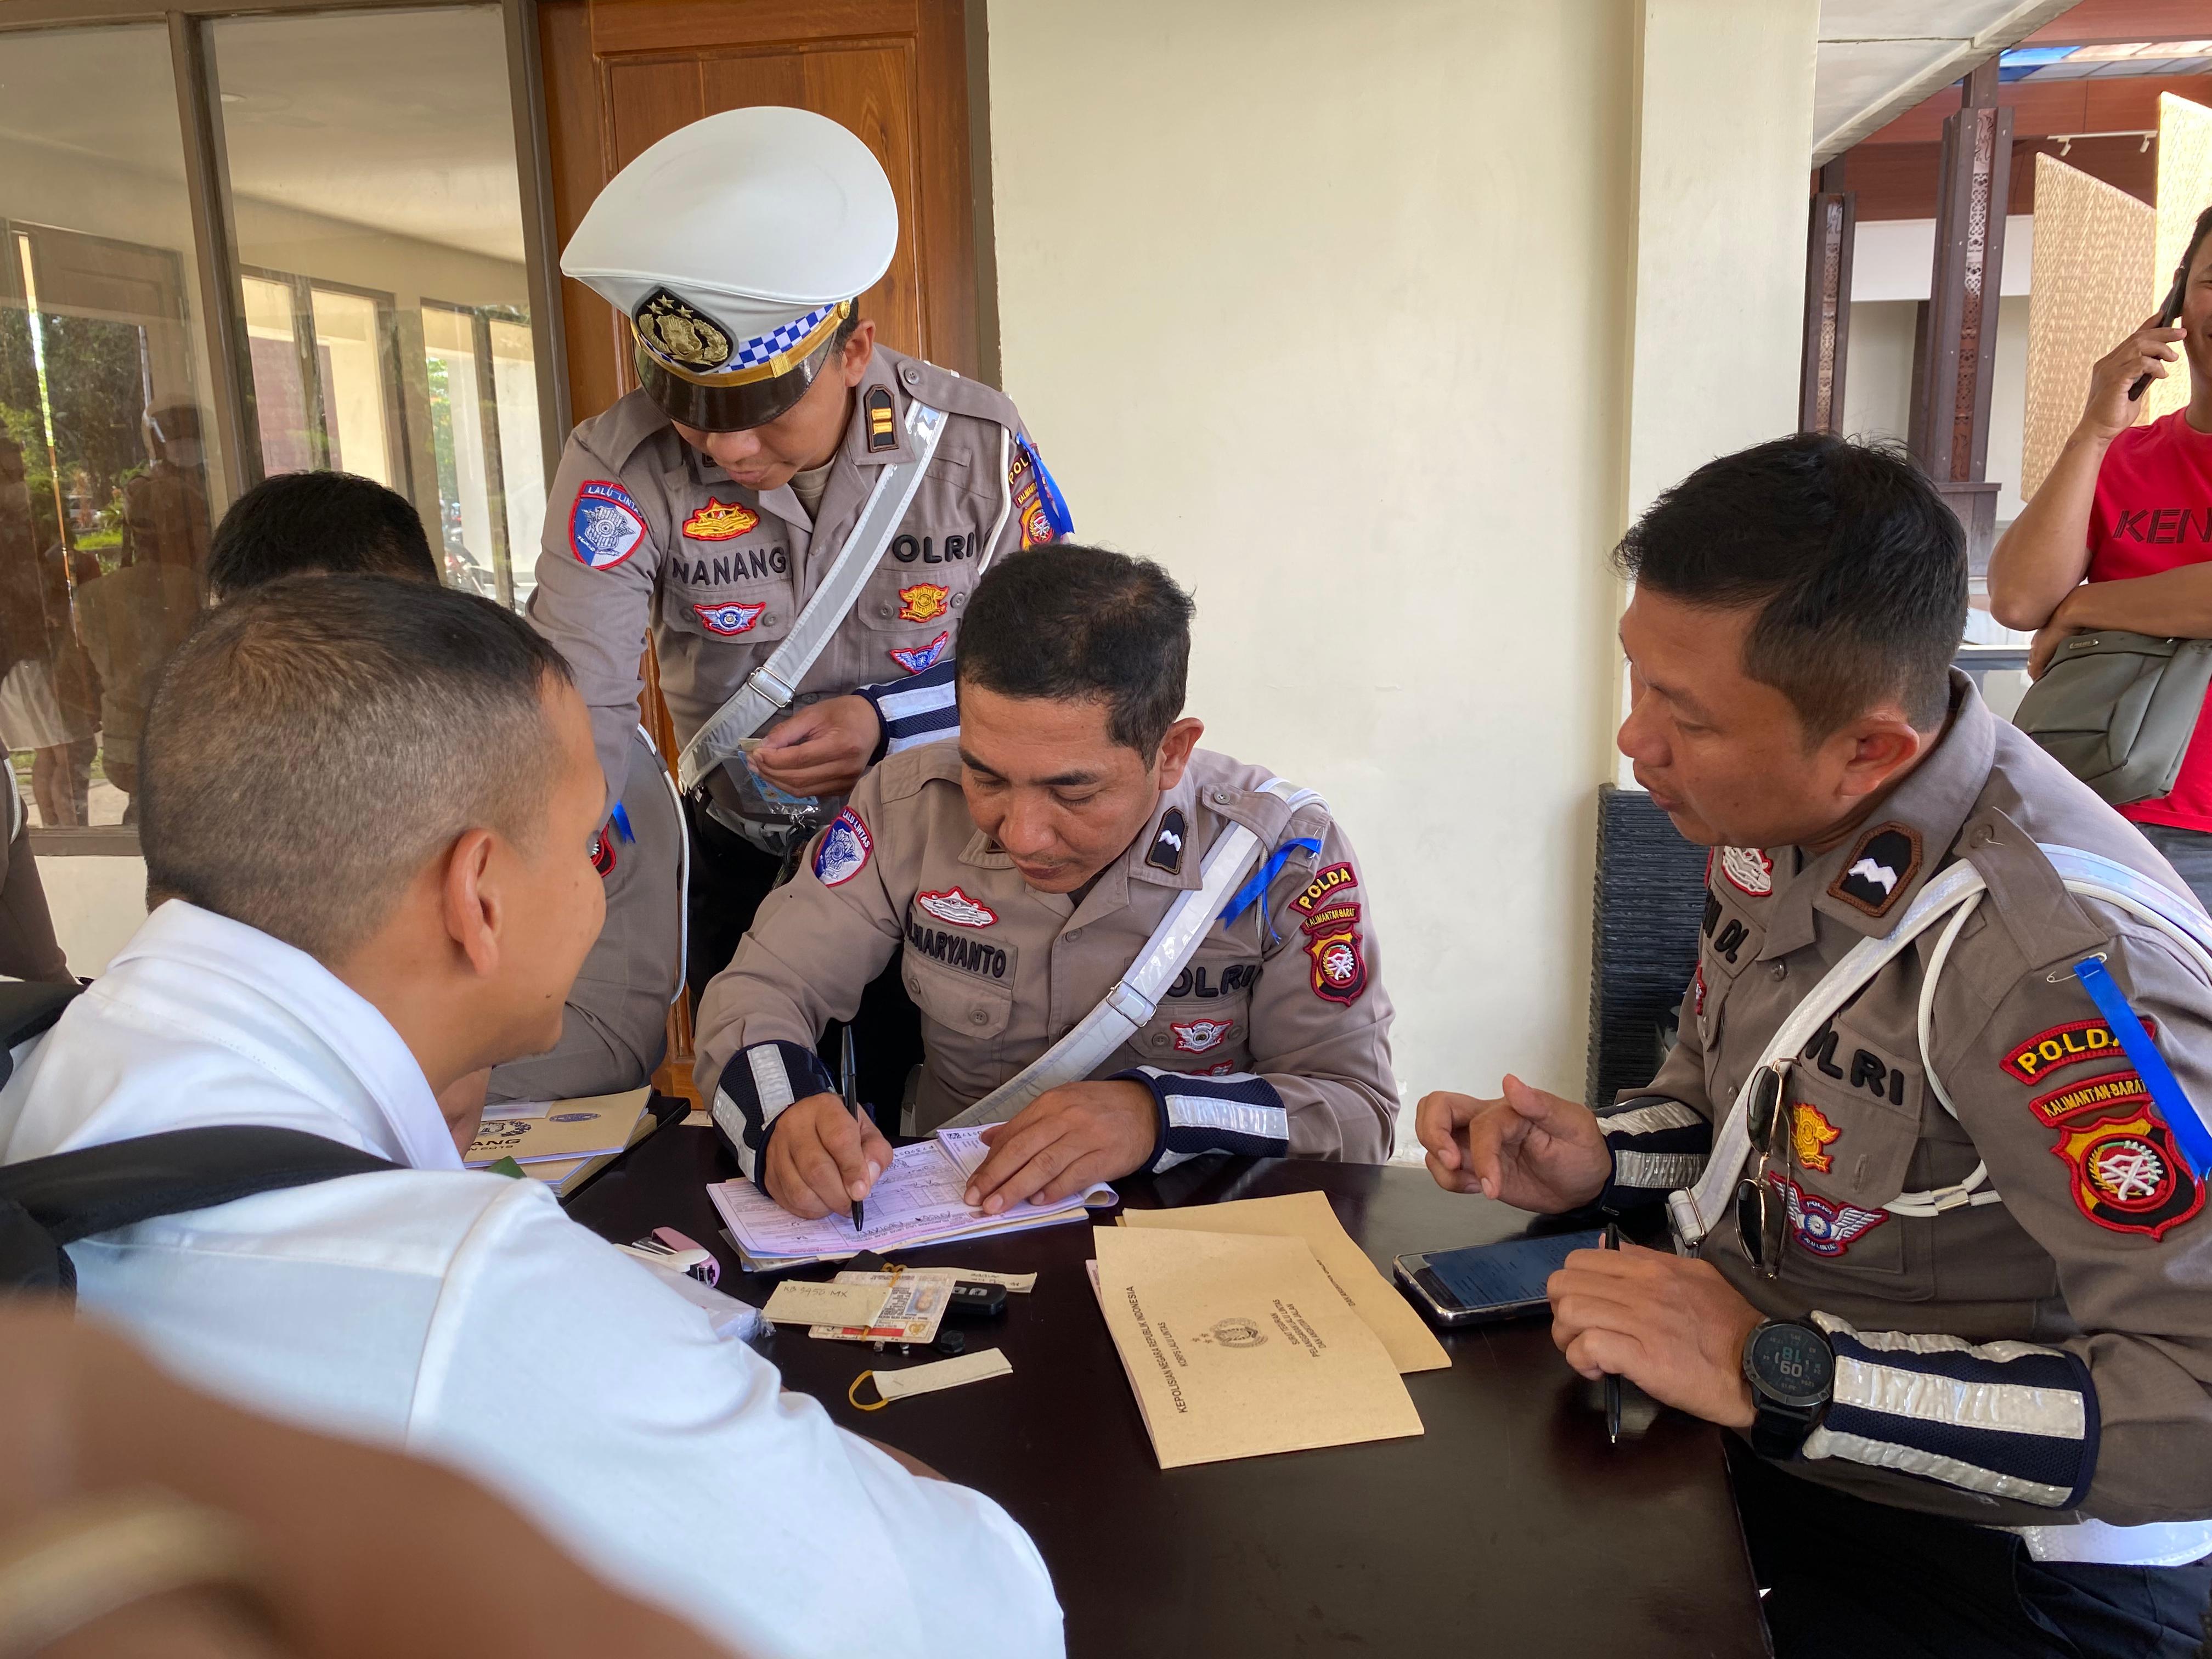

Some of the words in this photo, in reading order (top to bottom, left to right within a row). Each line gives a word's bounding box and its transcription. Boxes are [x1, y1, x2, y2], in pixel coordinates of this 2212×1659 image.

[1009, 452, 1031, 484] POL
[588, 486, 613, 496] LALU
[618, 493, 642, 518] LINTA
[892, 532, 974, 563] OLRI
[672, 546, 786, 585] NANANG
[843, 810, 855, 823] LALU
[1299, 868, 1351, 909] POLDA
[1166, 964, 1256, 997] OLRI
[2017, 1029, 2119, 1074] POLD
[1126, 1286, 1145, 1323] INDONESIA
[1138, 1321, 1158, 1349] REPUBLIK
[1158, 1322, 1172, 1339] LINTAS
[1152, 1347, 1170, 1370] NEGARA
[1173, 1349, 1188, 1368] KORPS
[1163, 1369, 1188, 1414] KEPOLISIAN
